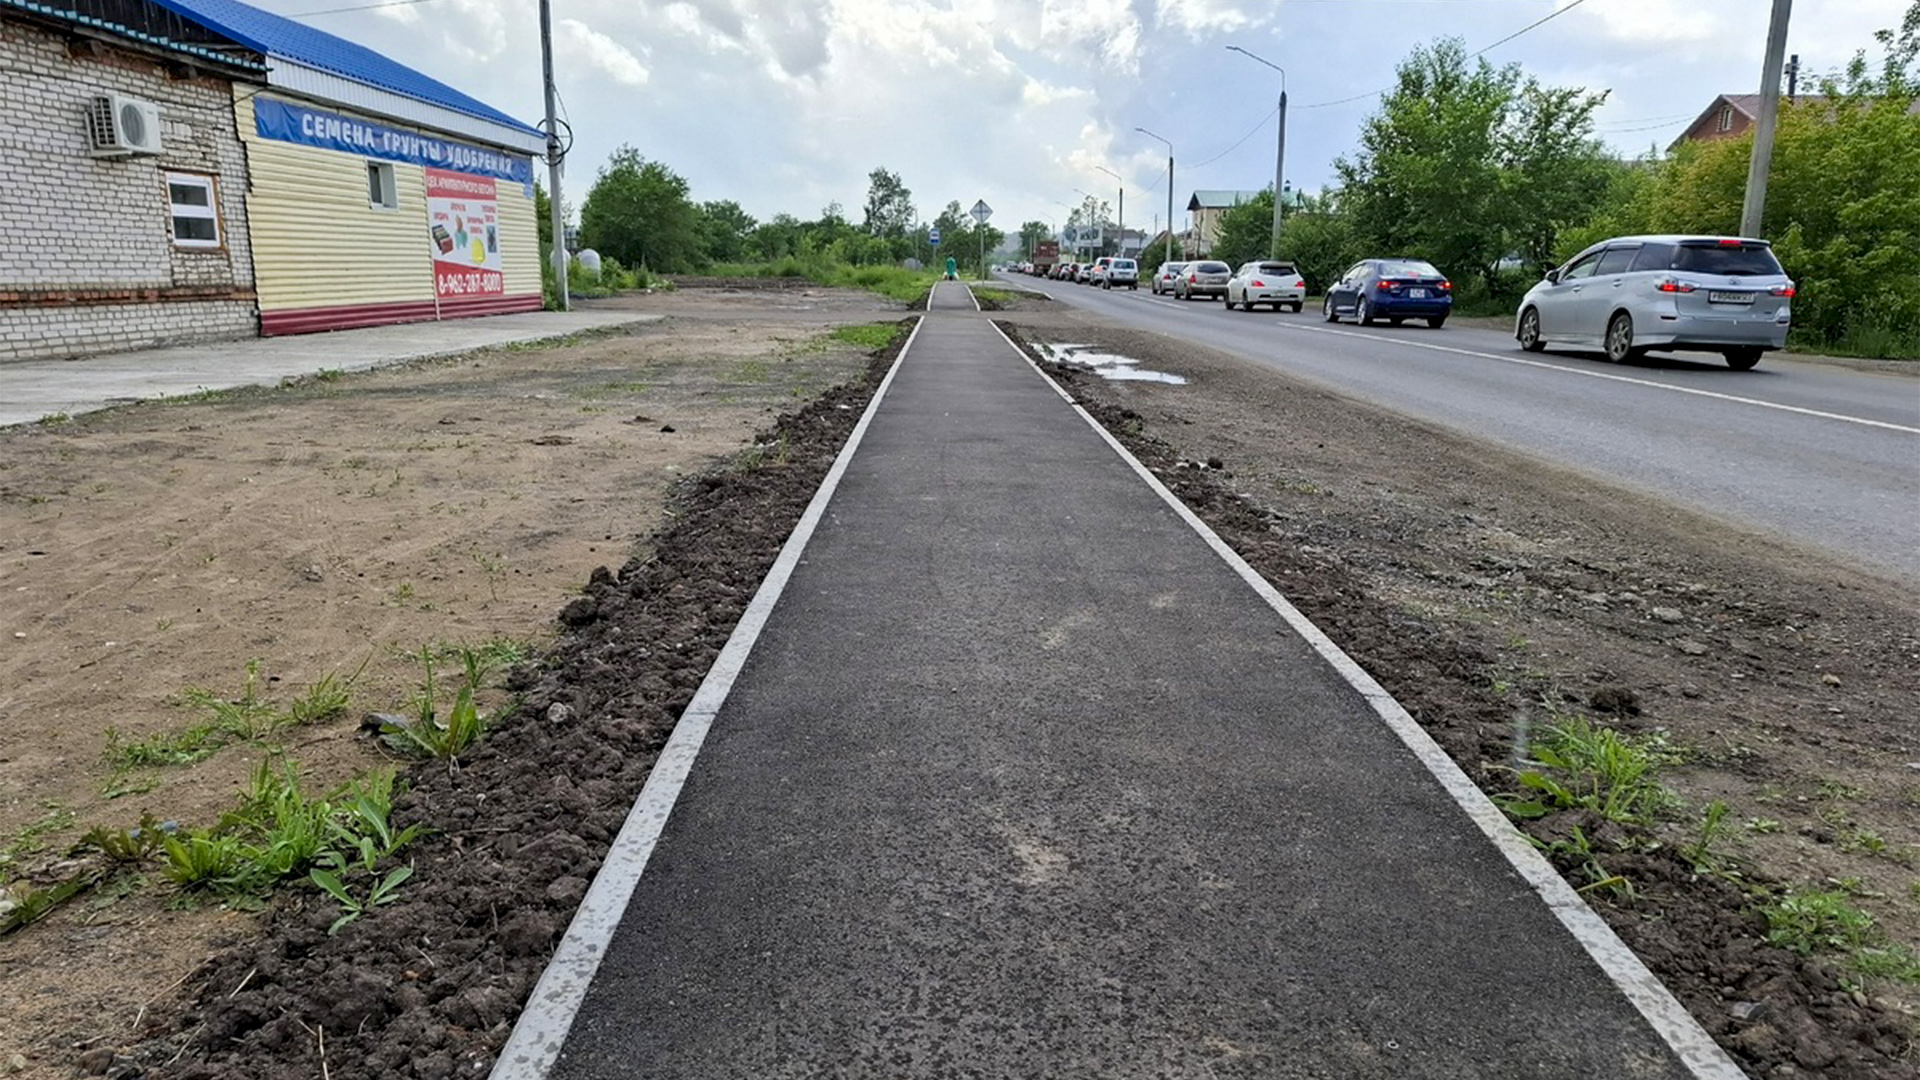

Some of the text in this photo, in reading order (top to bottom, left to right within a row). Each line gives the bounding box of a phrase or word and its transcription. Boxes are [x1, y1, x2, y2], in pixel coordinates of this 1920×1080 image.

[302, 113, 512, 173] СЕМЕНА ГРУНТЫ УДОБРЕНИЯ
[438, 273, 501, 295] 8-962-287-8000
